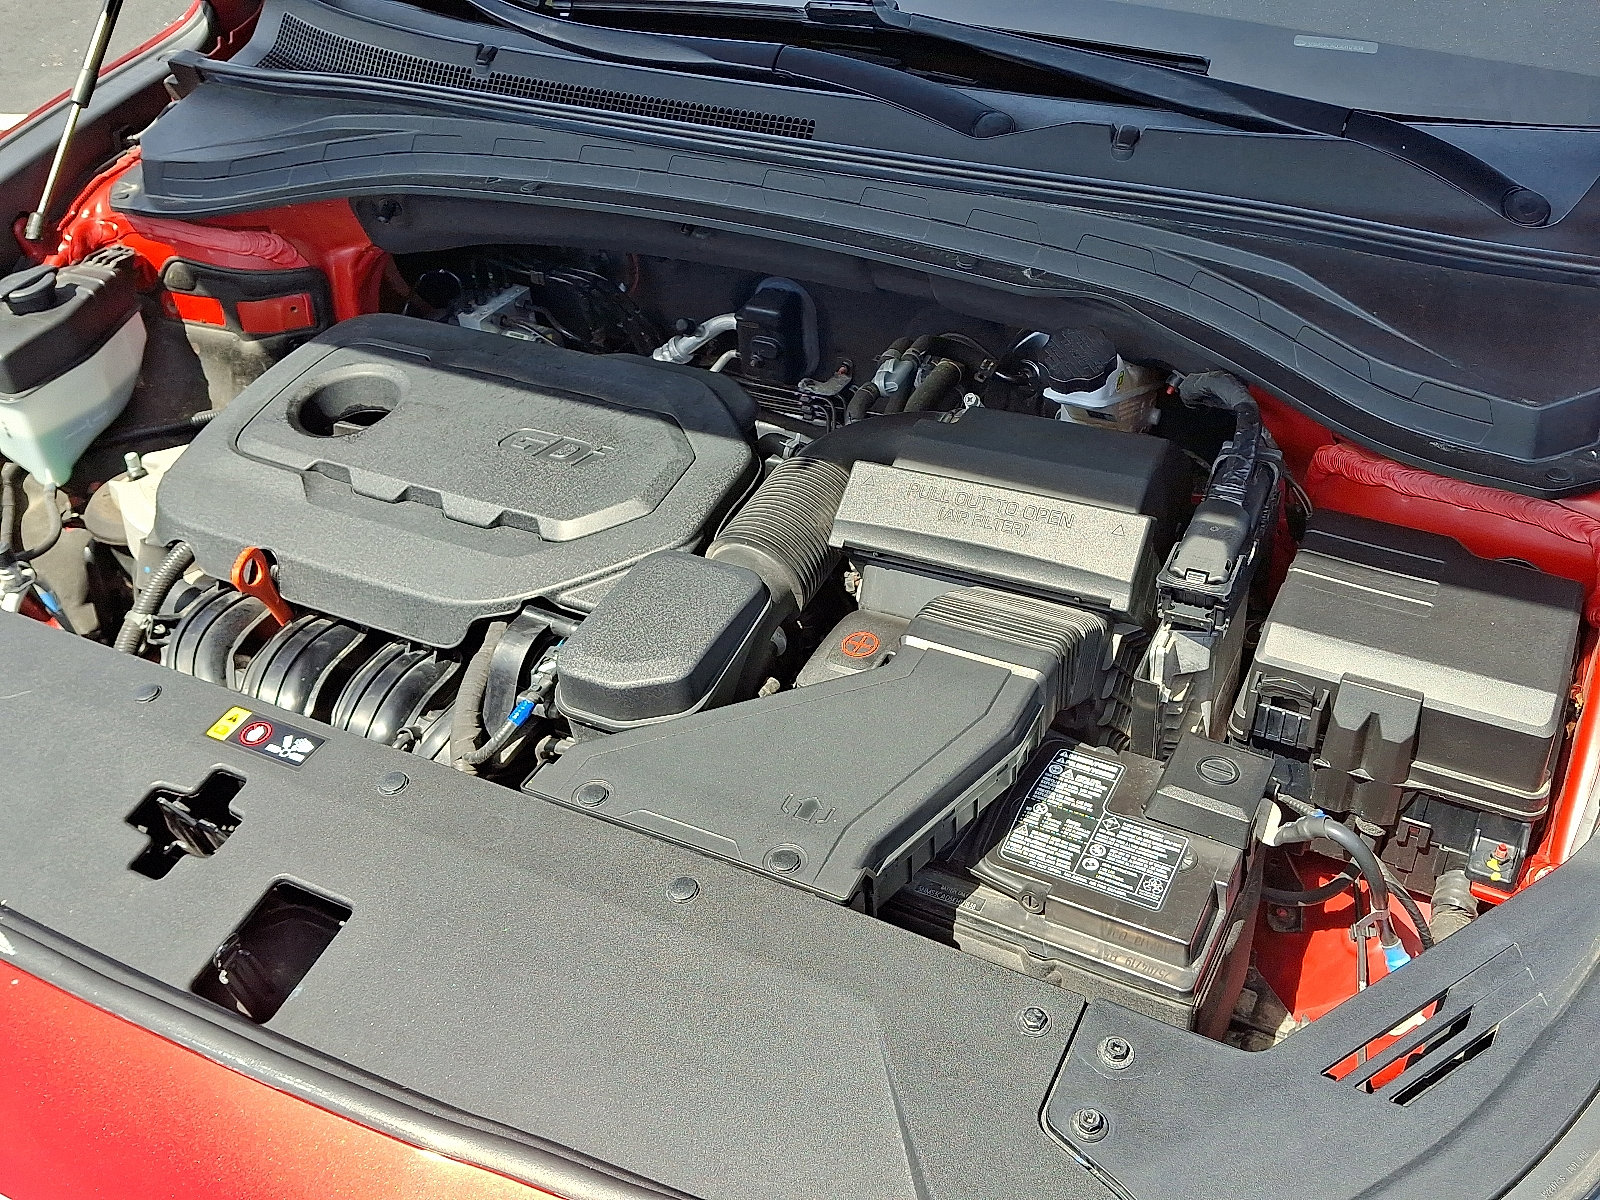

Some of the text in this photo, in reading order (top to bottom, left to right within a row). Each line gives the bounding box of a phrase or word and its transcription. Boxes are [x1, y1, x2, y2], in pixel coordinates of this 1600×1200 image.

[907, 482, 1076, 529] PULL OUT TO OPEN
